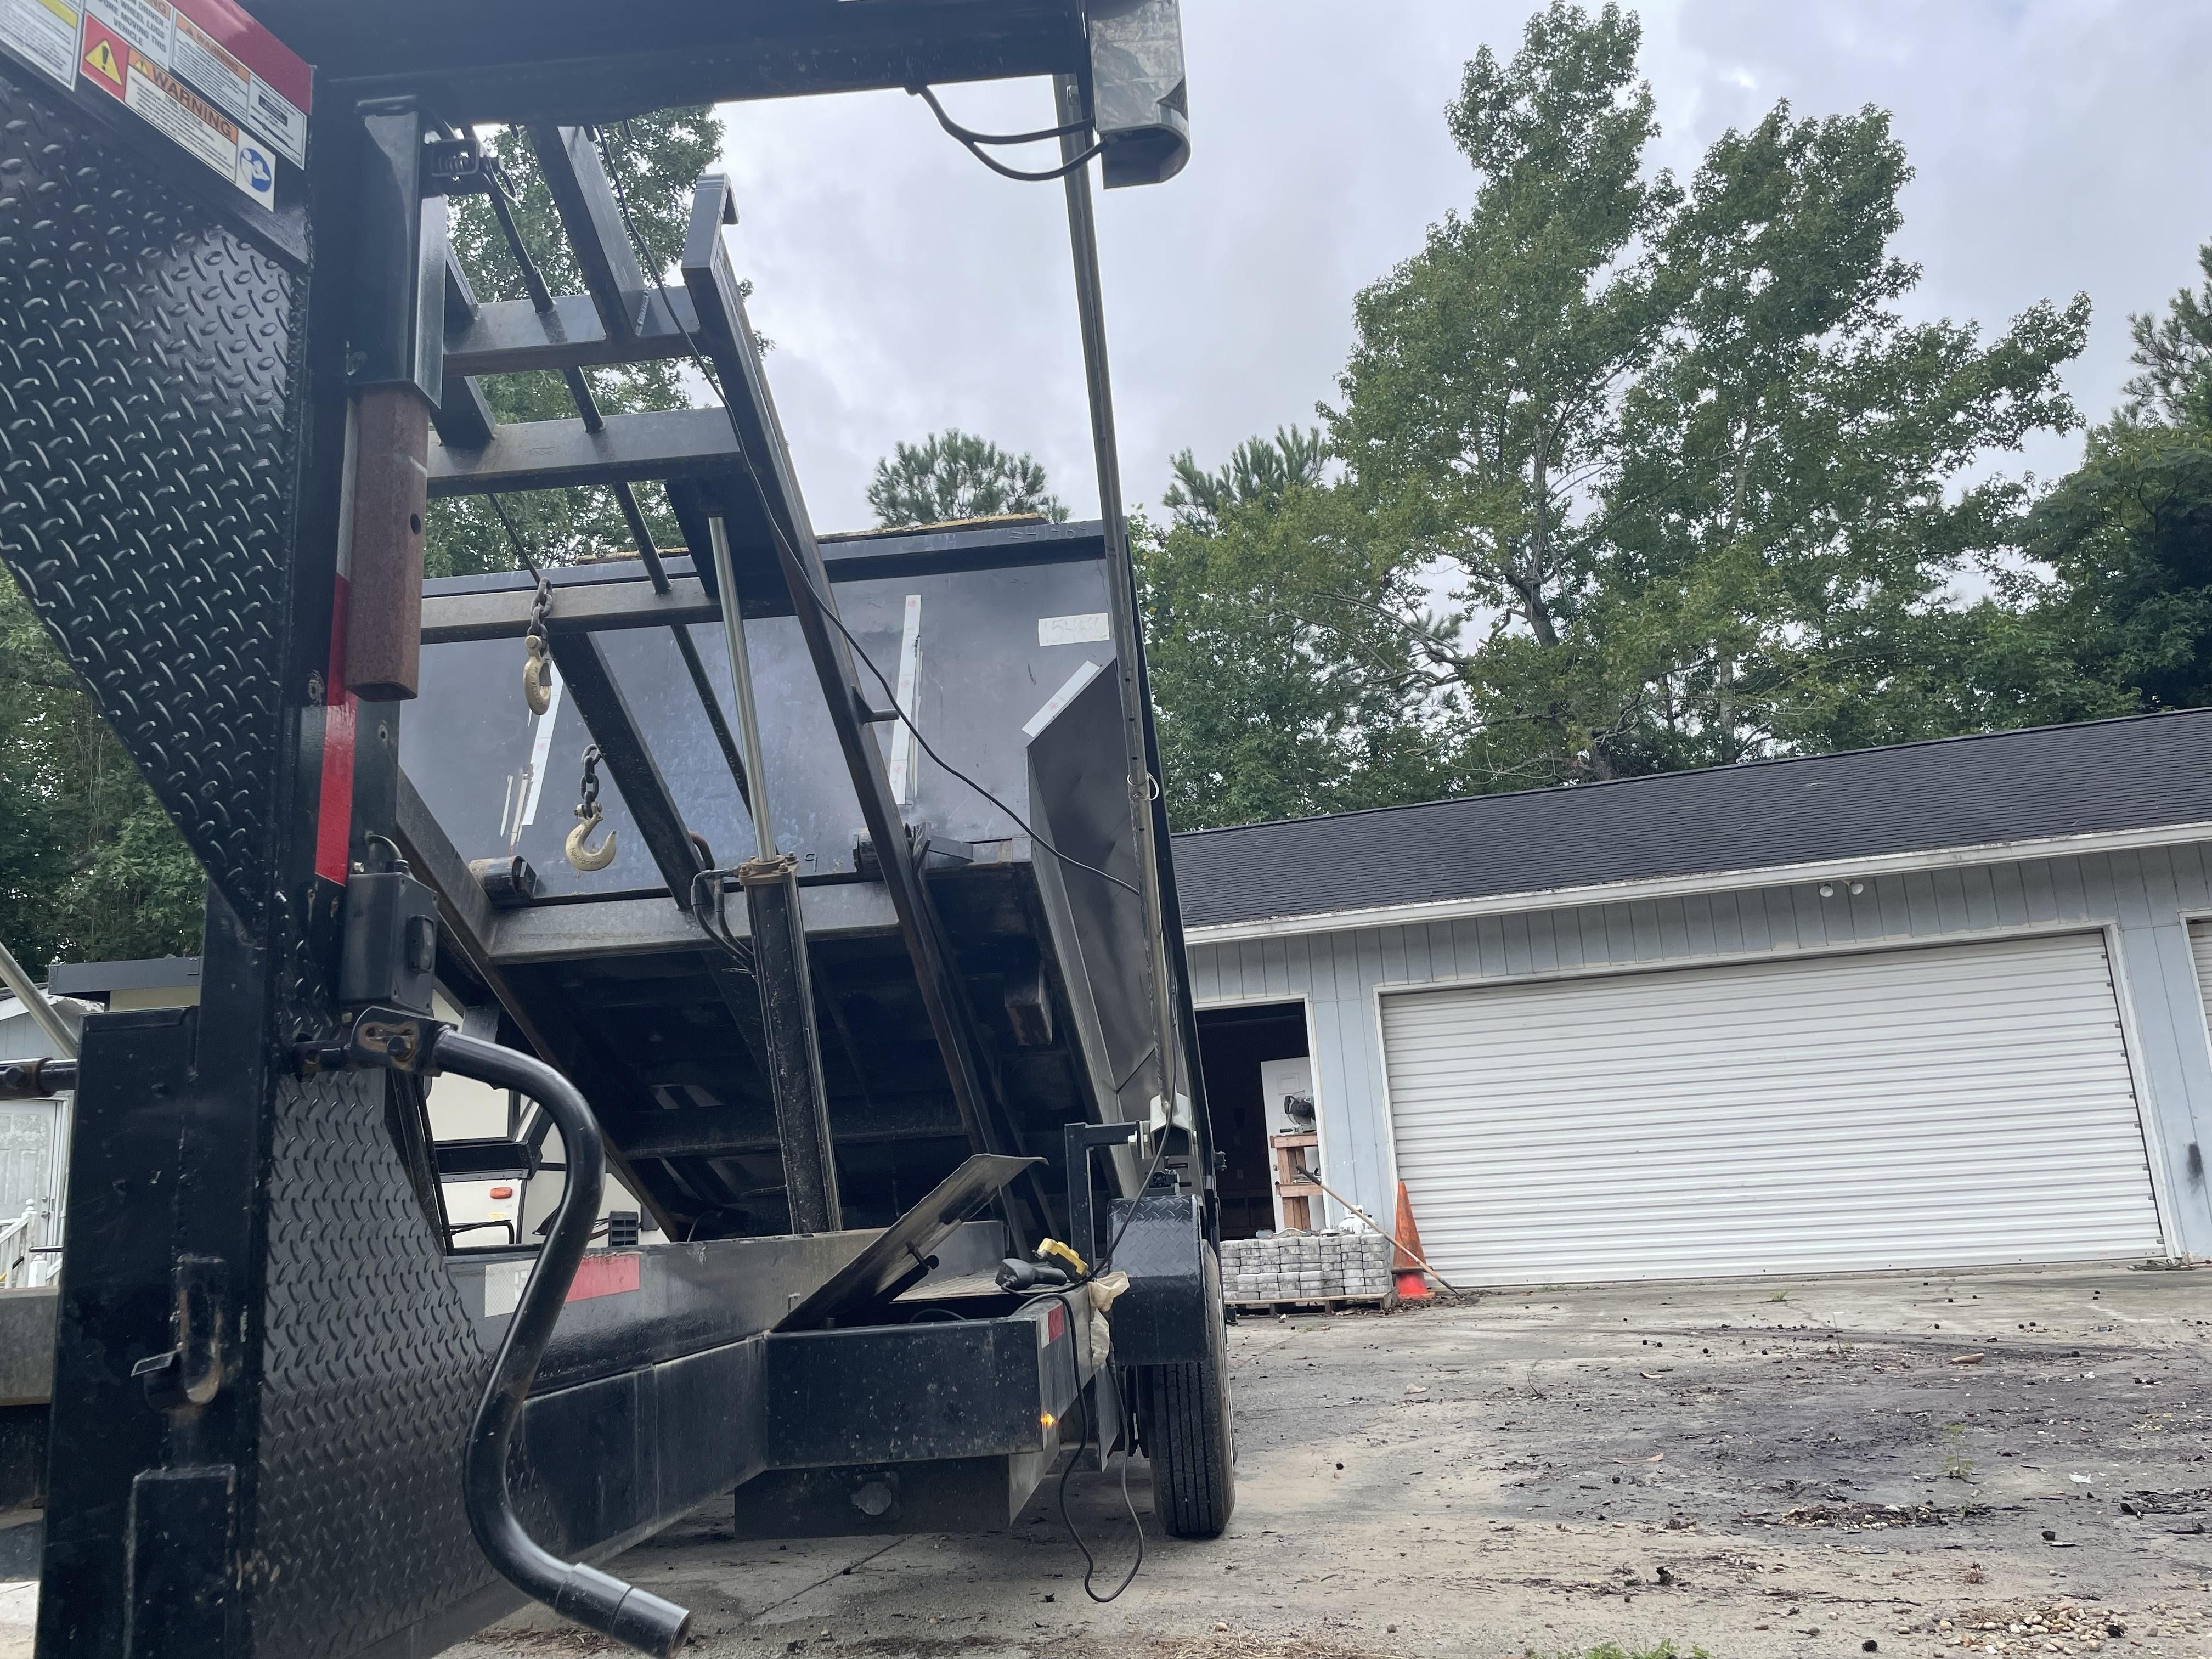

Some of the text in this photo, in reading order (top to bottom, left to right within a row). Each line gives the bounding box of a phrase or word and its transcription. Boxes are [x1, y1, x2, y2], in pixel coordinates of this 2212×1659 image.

[114, 18, 143, 46] VEHICLE
[121, 0, 144, 24] WHEEL
[146, 20, 165, 39] LUGS
[121, 12, 149, 39] MOVING
[151, 35, 167, 52] THIS
[138, 1, 163, 26] DRIVER
[196, 32, 239, 72] WARNING
[152, 65, 232, 137] WARNING
